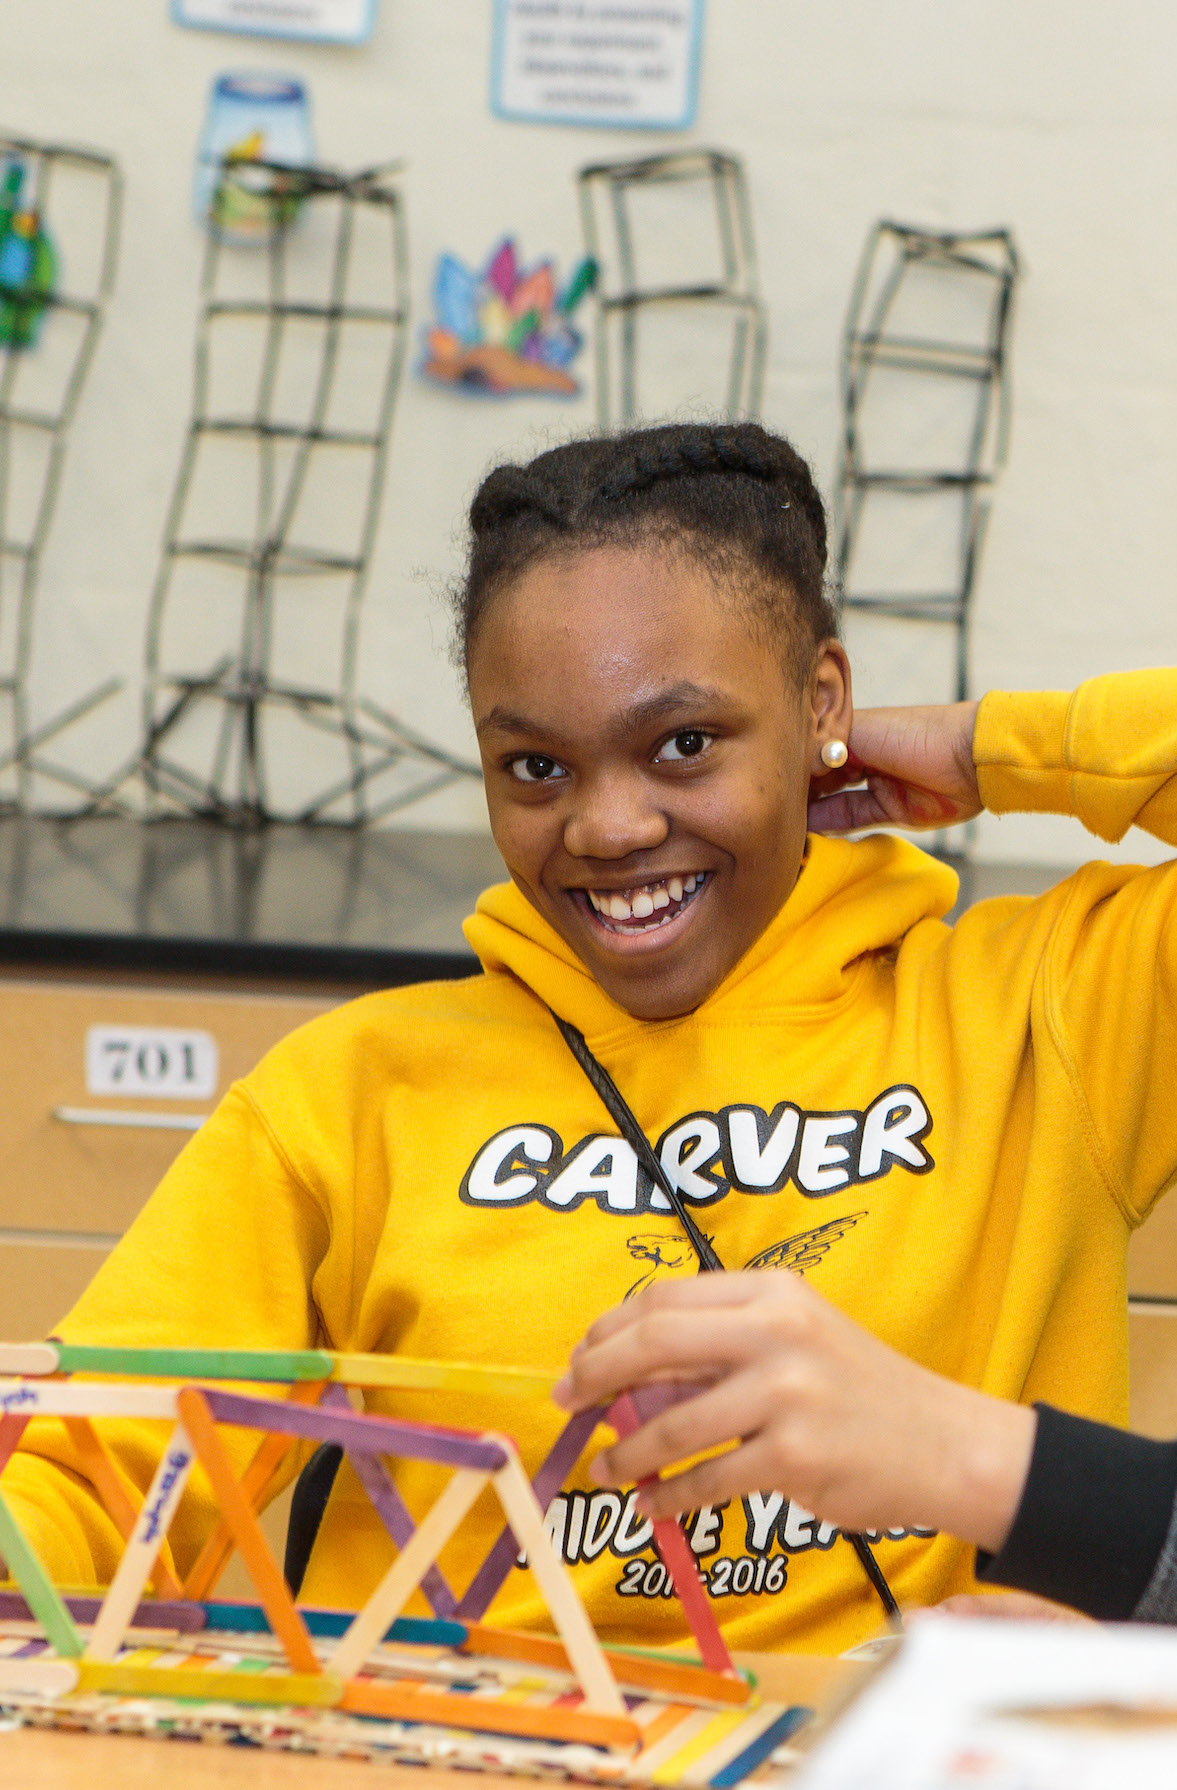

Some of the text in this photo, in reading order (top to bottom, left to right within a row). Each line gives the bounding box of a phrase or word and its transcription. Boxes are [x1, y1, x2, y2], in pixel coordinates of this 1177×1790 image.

[102, 1040, 198, 1083] 701
[460, 1084, 936, 1216] CARVER
[516, 1490, 731, 1569] MIDDE
